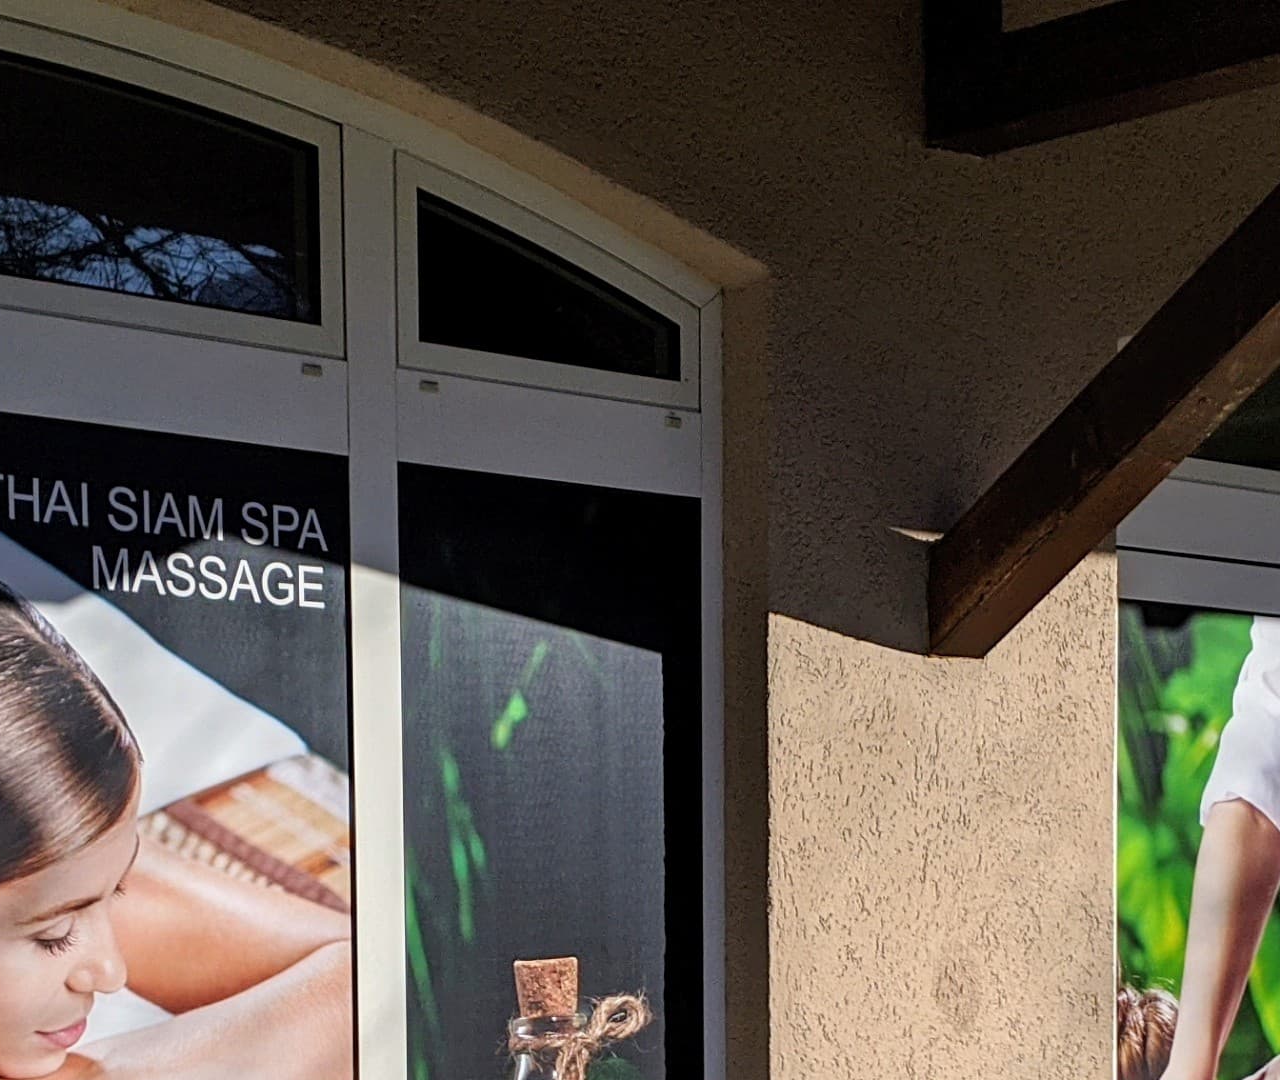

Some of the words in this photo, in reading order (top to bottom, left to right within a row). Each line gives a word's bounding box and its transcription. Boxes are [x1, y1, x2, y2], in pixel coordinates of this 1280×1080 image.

[108, 486, 224, 542] SIAM
[240, 502, 328, 552] SPA
[93, 545, 325, 609] MASSAGE
